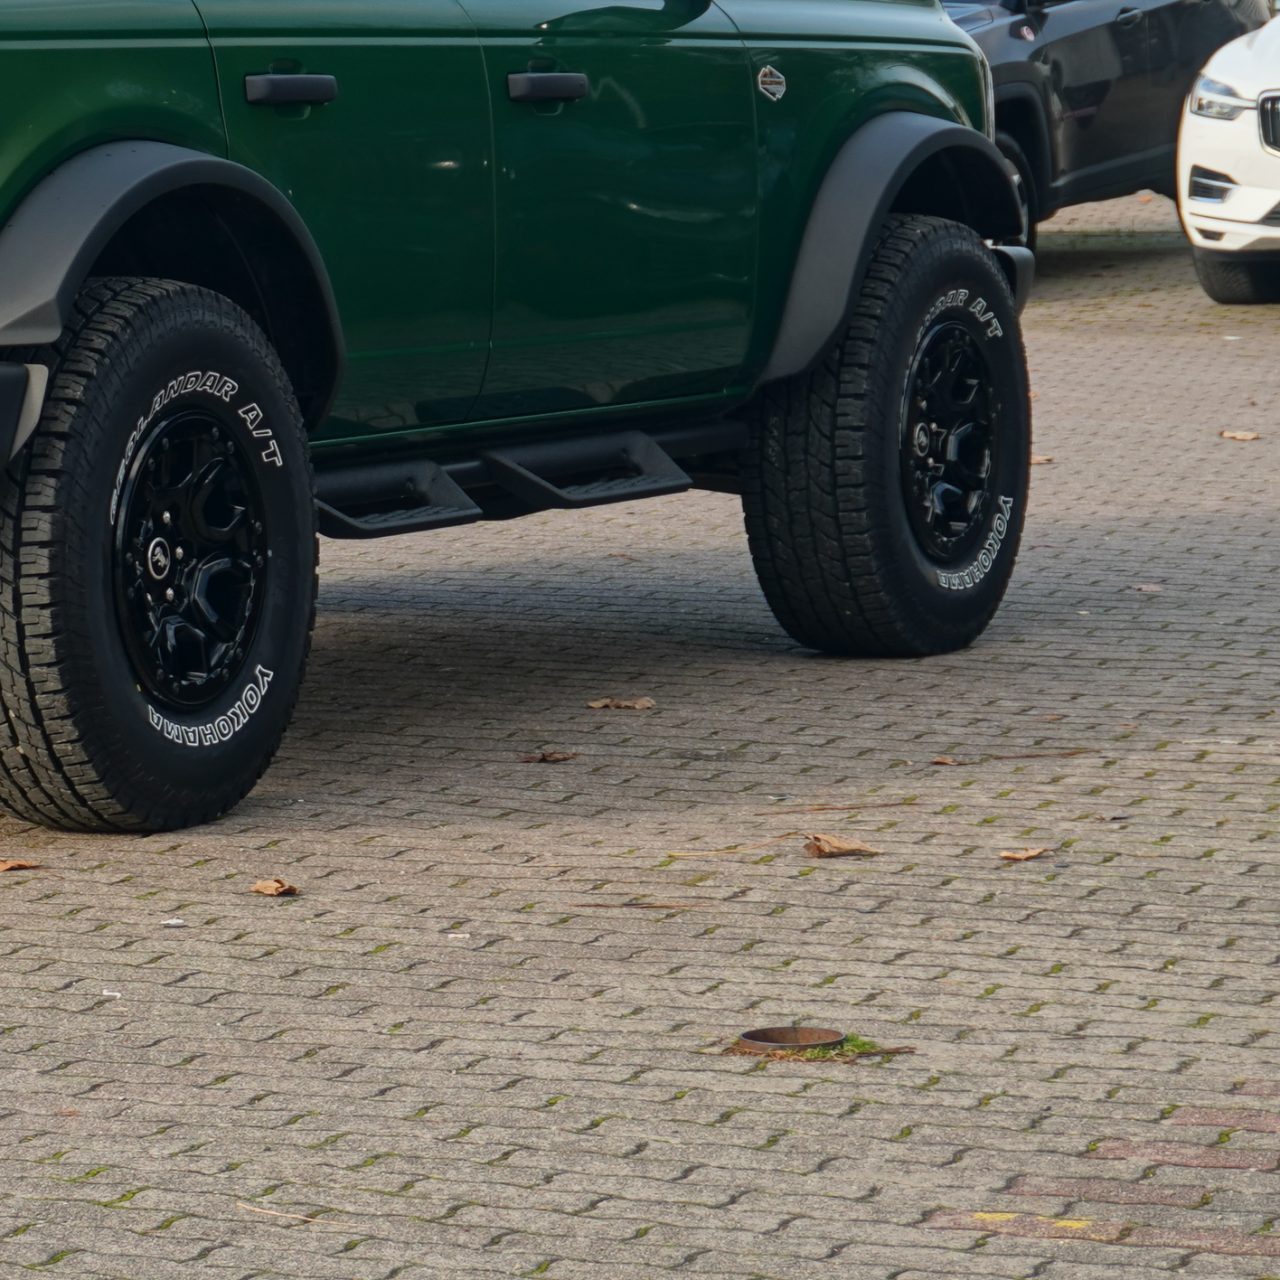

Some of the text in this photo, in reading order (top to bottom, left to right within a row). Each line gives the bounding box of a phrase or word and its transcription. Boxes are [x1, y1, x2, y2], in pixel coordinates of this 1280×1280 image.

[969, 298, 1004, 337] A/T
[238, 403, 283, 467] A/T
[937, 496, 1014, 591] YOKOHAMA
[148, 664, 274, 747] YOKOHAMA
